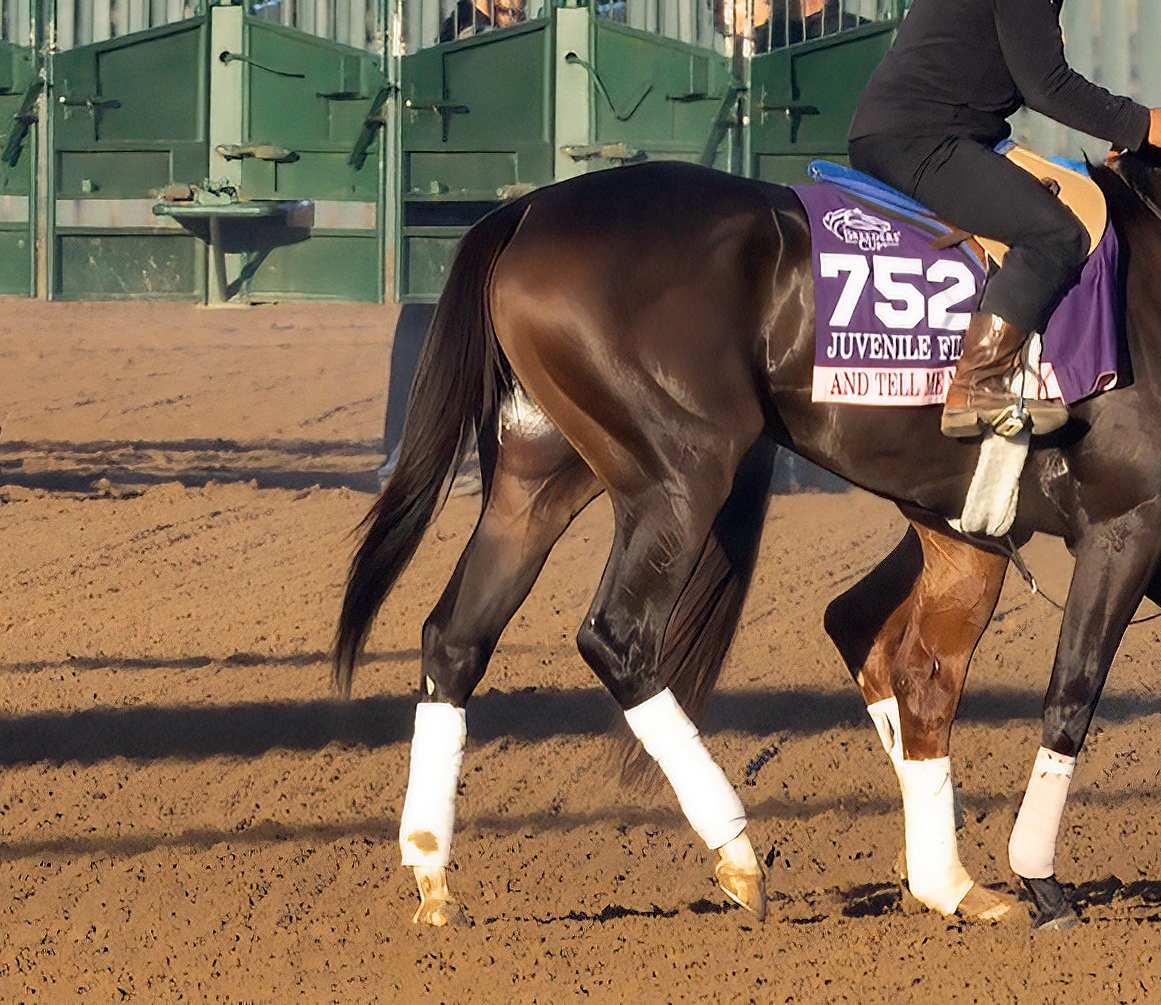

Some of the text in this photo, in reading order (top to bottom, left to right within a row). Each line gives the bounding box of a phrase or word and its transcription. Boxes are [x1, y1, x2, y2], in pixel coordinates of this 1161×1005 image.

[820, 252, 976, 331] 752
[826, 331, 932, 360] JUVENILE
[830, 370, 869, 397] AND
[875, 371, 920, 397] TELL
[924, 370, 945, 397] ME
